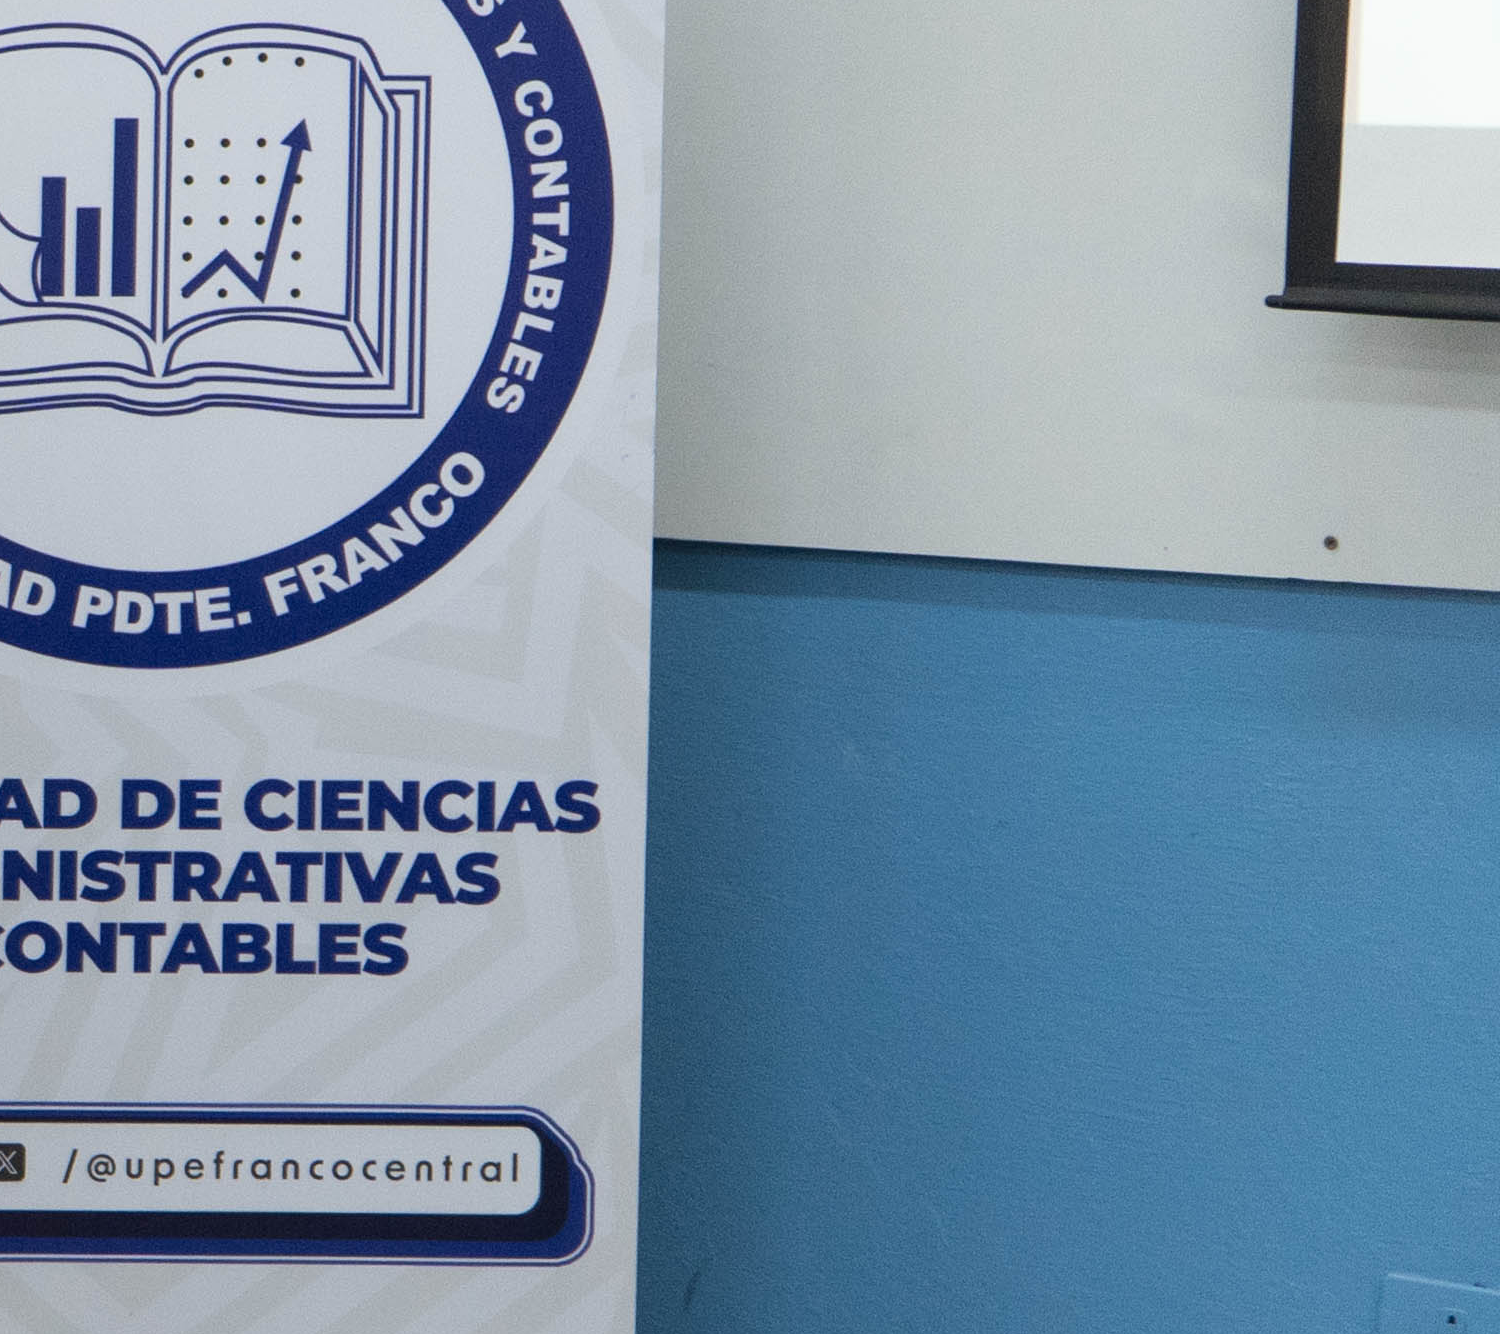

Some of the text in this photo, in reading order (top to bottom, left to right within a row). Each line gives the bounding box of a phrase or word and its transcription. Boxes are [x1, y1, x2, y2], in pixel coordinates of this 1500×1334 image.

[495, 22, 536, 58] Y
[487, 80, 569, 412] CONTABLES
[262, 450, 486, 615] FRANCO
[121, 779, 221, 830] DE
[244, 779, 600, 833] CIENCIAS
